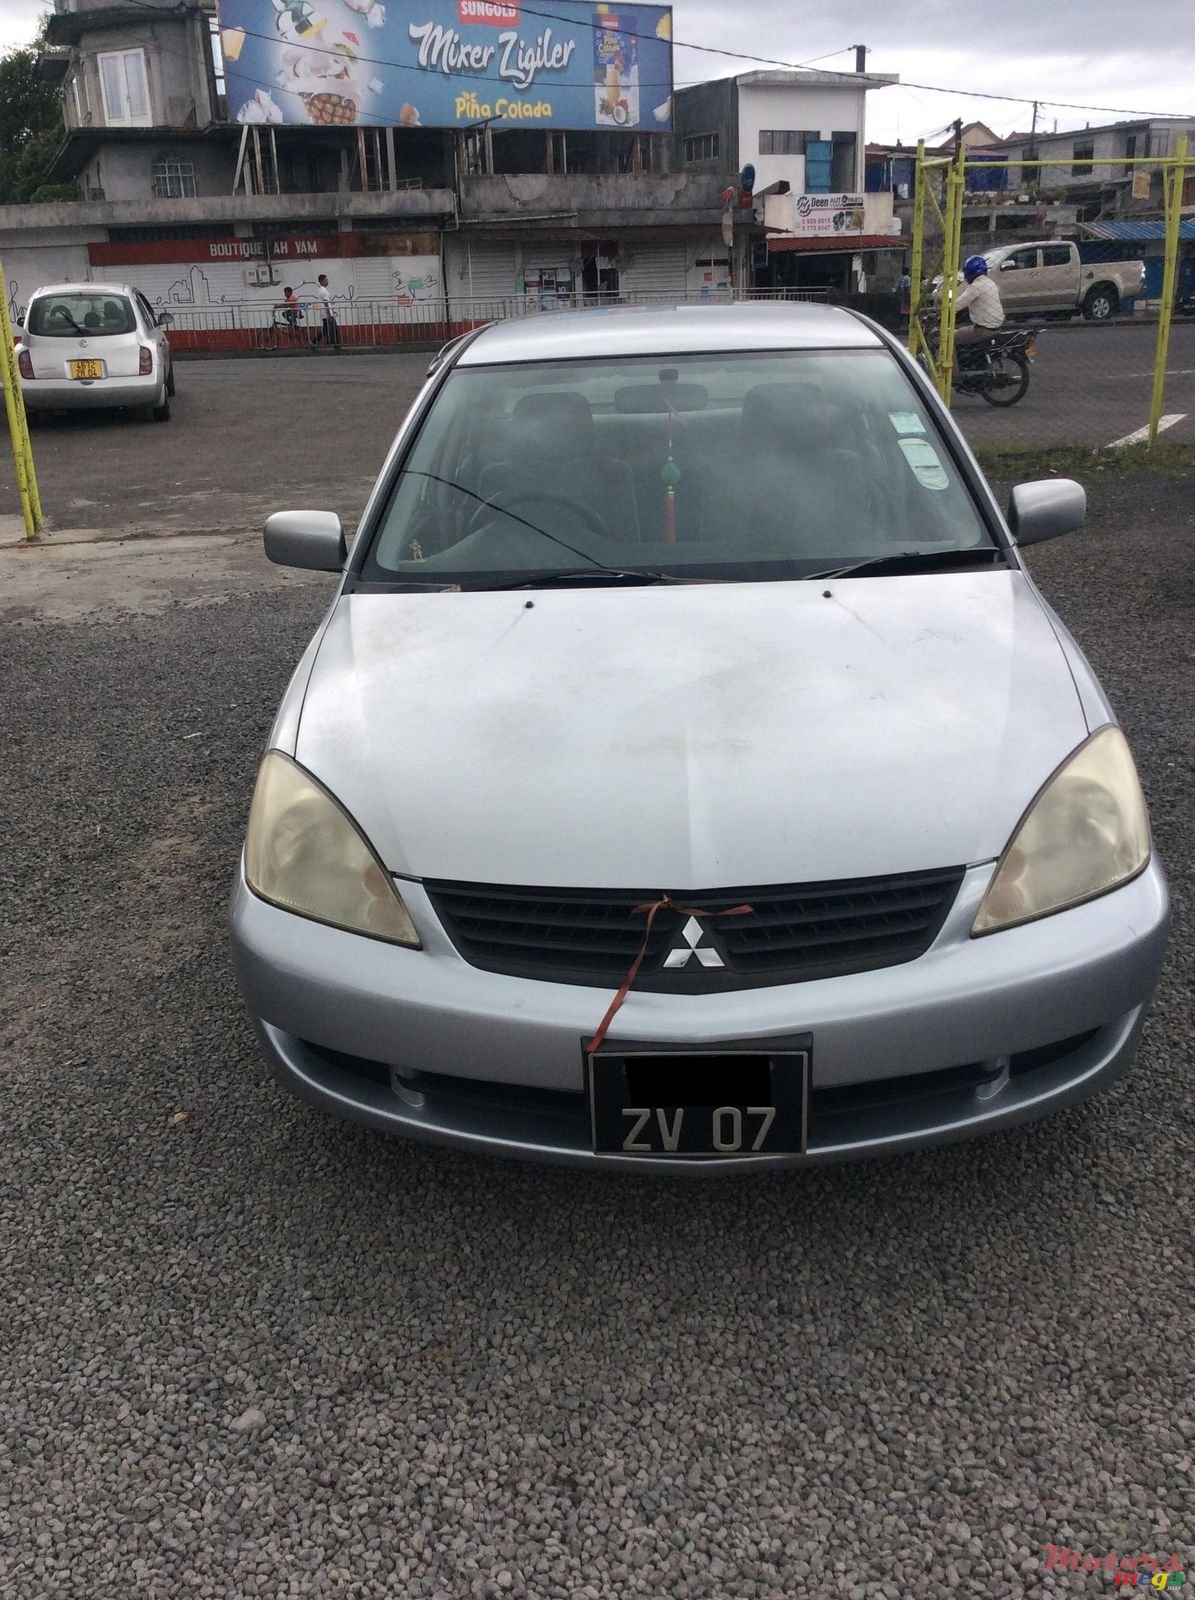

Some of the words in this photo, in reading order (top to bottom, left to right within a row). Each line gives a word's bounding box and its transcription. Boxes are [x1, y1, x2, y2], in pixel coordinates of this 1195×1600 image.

[460, 0, 517, 18] SUNGOLD
[408, 21, 495, 74] Mixer
[498, 28, 576, 89] Zigiler
[495, 98, 552, 119] Colada
[810, 197, 829, 208] Deen
[209, 241, 264, 257] BOUTIQUE
[273, 241, 288, 254] AH
[294, 240, 318, 254] YAM
[621, 1107, 685, 1152] ZV
[712, 1106, 777, 1152] 07
